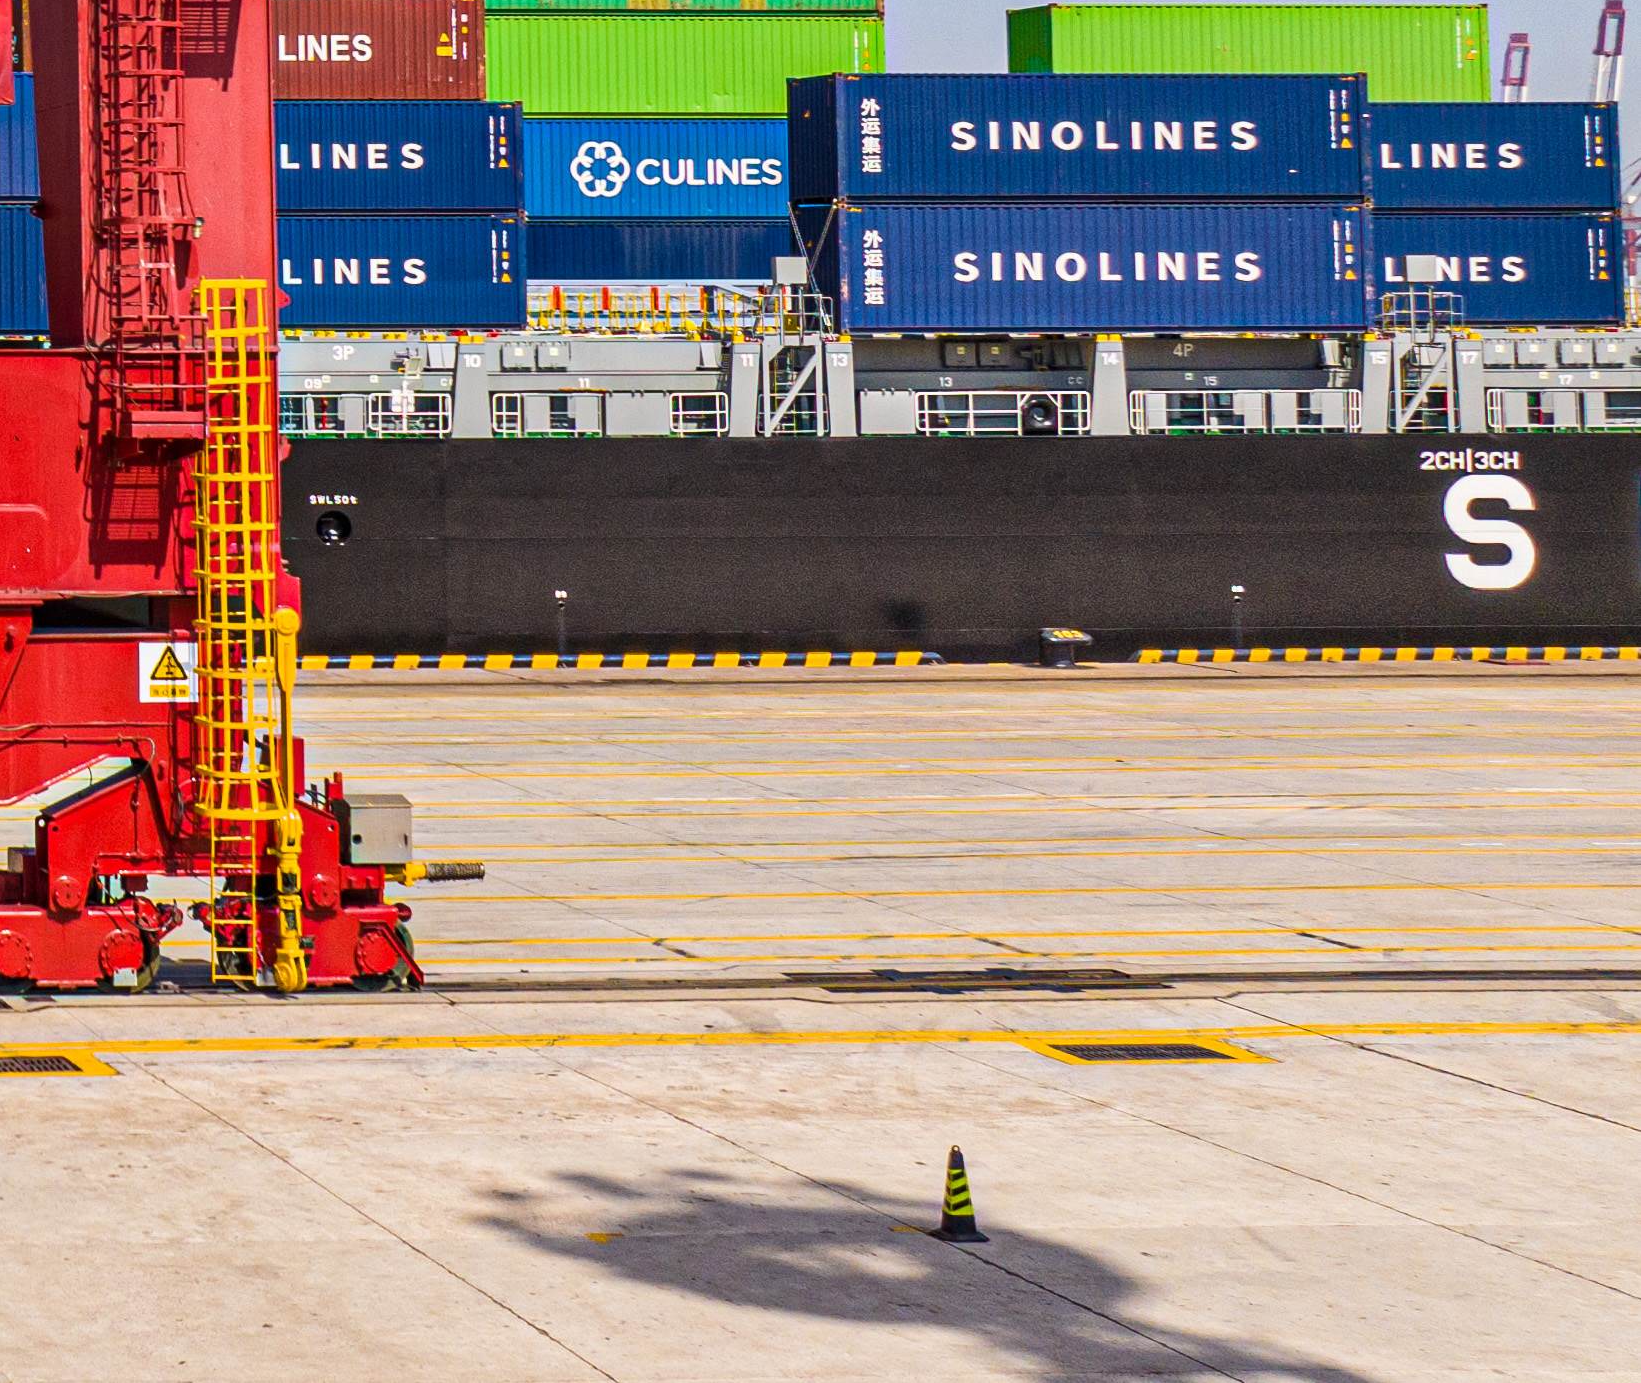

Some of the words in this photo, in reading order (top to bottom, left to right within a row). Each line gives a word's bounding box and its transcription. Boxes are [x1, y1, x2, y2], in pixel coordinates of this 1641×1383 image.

[278, 34, 374, 63] LINES
[860, 98, 882, 173] 外运集运
[950, 121, 1259, 151] SINOLINES
[279, 143, 426, 171] LINES
[1380, 143, 1524, 168] LINES
[635, 158, 784, 186] CULINES
[282, 258, 429, 286] LINES
[862, 229, 885, 305] 外运集运
[953, 251, 1263, 282] SINOLINES
[1384, 256, 1527, 283] LNES
[332, 345, 355, 361] 3P
[1172, 343, 1194, 357] 4P
[463, 353, 482, 368] 10
[740, 353, 755, 367] 11
[831, 353, 848, 368] 13
[1101, 352, 1119, 365] 14
[1370, 352, 1388, 365] 15
[1460, 352, 1478, 365] 17
[578, 378, 591, 389] 11
[939, 376, 953, 387] 13
[1203, 375, 1217, 386] 15
[1558, 374, 1574, 385] 17
[1443, 474, 1537, 590] S
